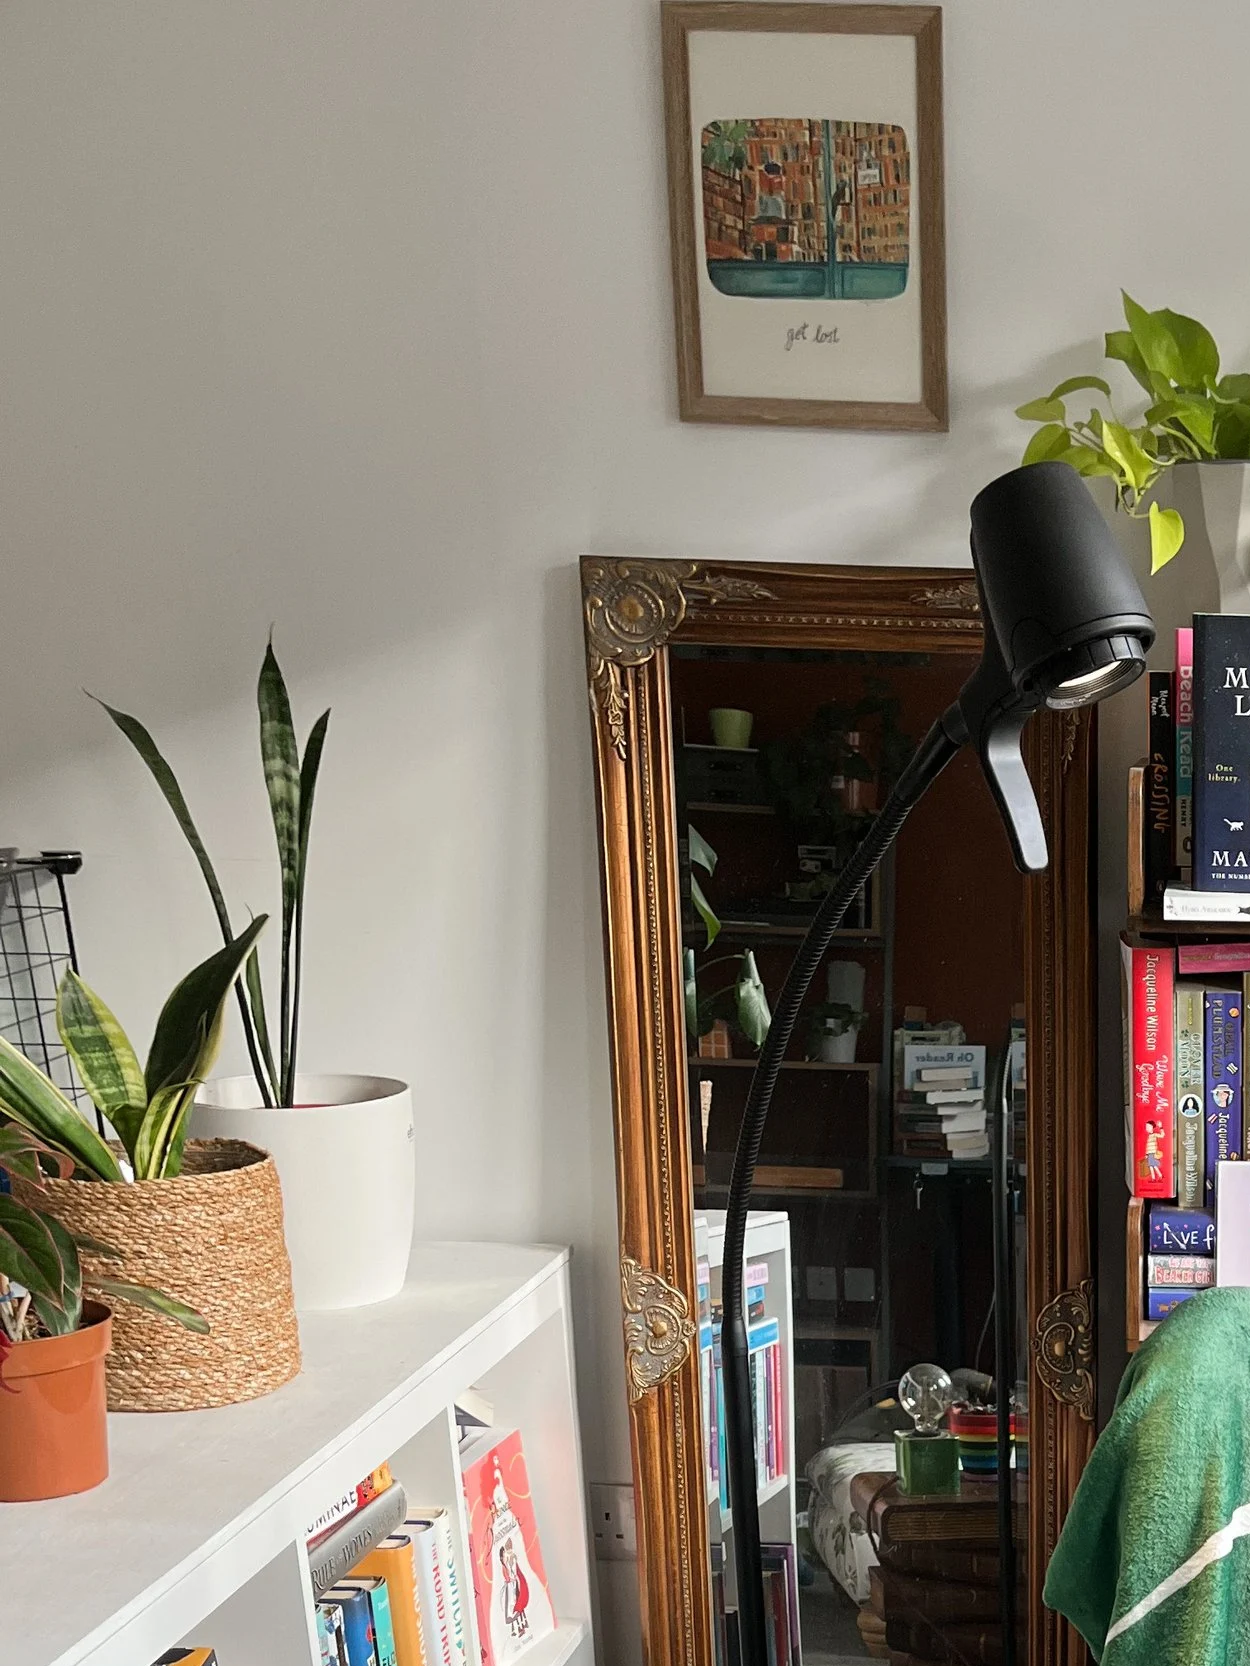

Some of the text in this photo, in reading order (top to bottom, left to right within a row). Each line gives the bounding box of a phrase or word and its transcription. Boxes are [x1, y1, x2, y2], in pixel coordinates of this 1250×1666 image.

[785, 322, 840, 351] get lost
[1215, 764, 1234, 773] One
[1210, 872, 1226, 881] THE
[1138, 953, 1161, 1051] Jacqueline Wilson
[1135, 1062, 1154, 1105] Goodbye
[1154, 1054, 1169, 1089] Wave
[1183, 1121, 1199, 1170] Jacqueline
[1212, 1112, 1230, 1160] Jacqueline
[431, 1563, 447, 1621] ROAD
[448, 1558, 466, 1637] SWITCH
